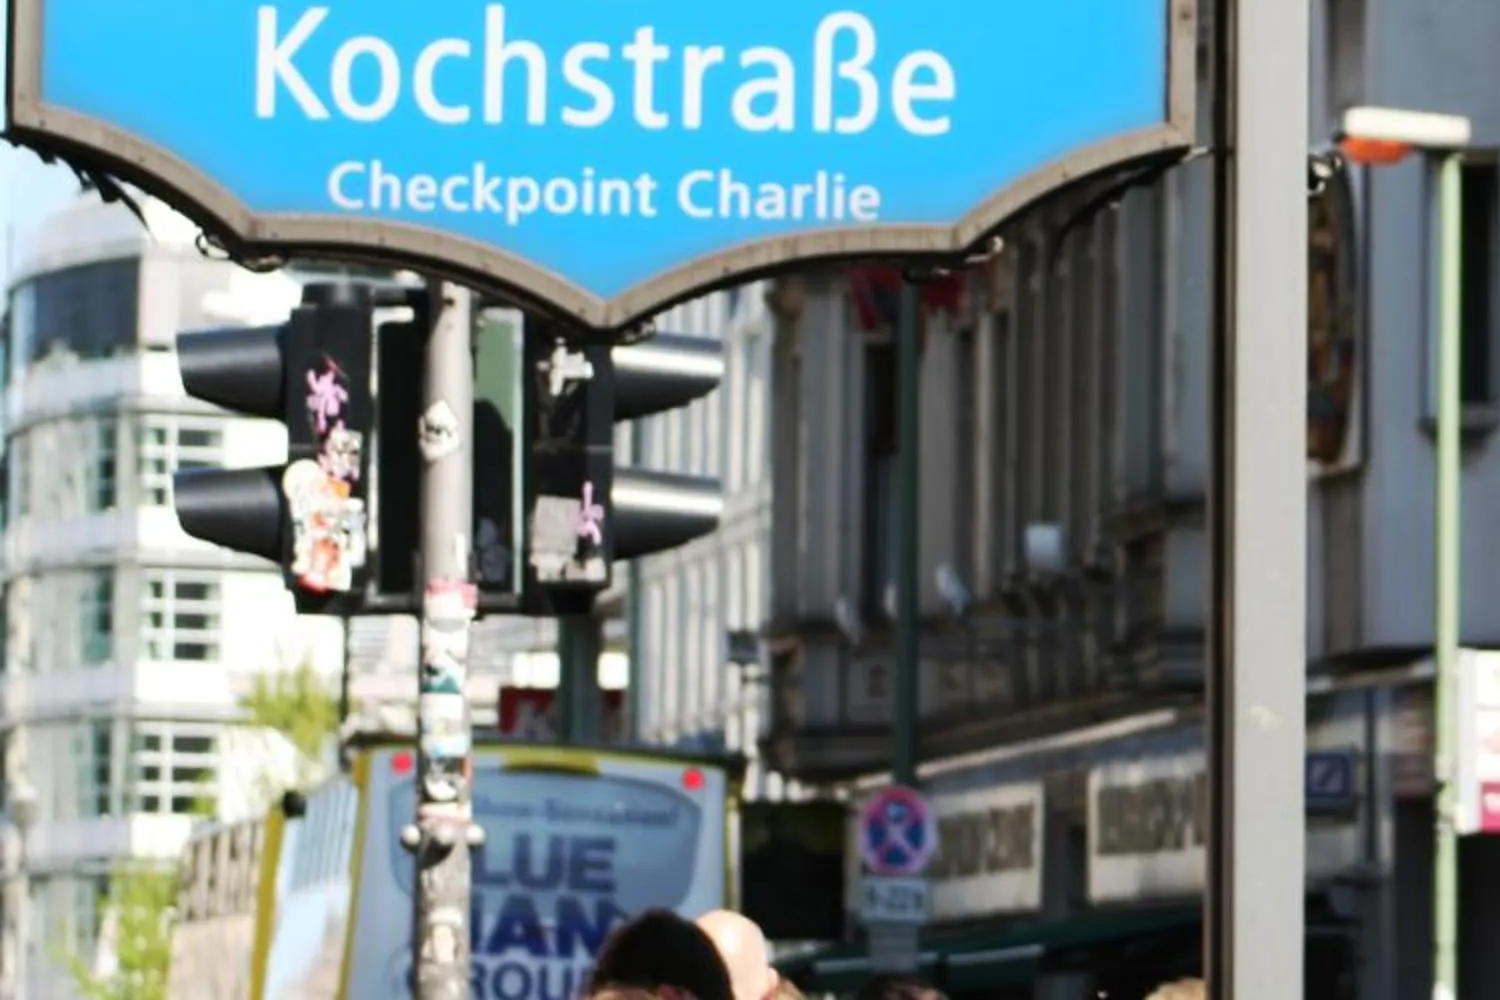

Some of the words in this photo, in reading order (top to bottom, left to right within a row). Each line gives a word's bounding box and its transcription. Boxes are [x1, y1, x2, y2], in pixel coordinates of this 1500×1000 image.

[254, 3, 957, 135] Kochstraße
[328, 160, 657, 224] Checkpoint
[677, 170, 881, 222] Charlie
[471, 832, 617, 893] LUE
[471, 893, 626, 957] AN
